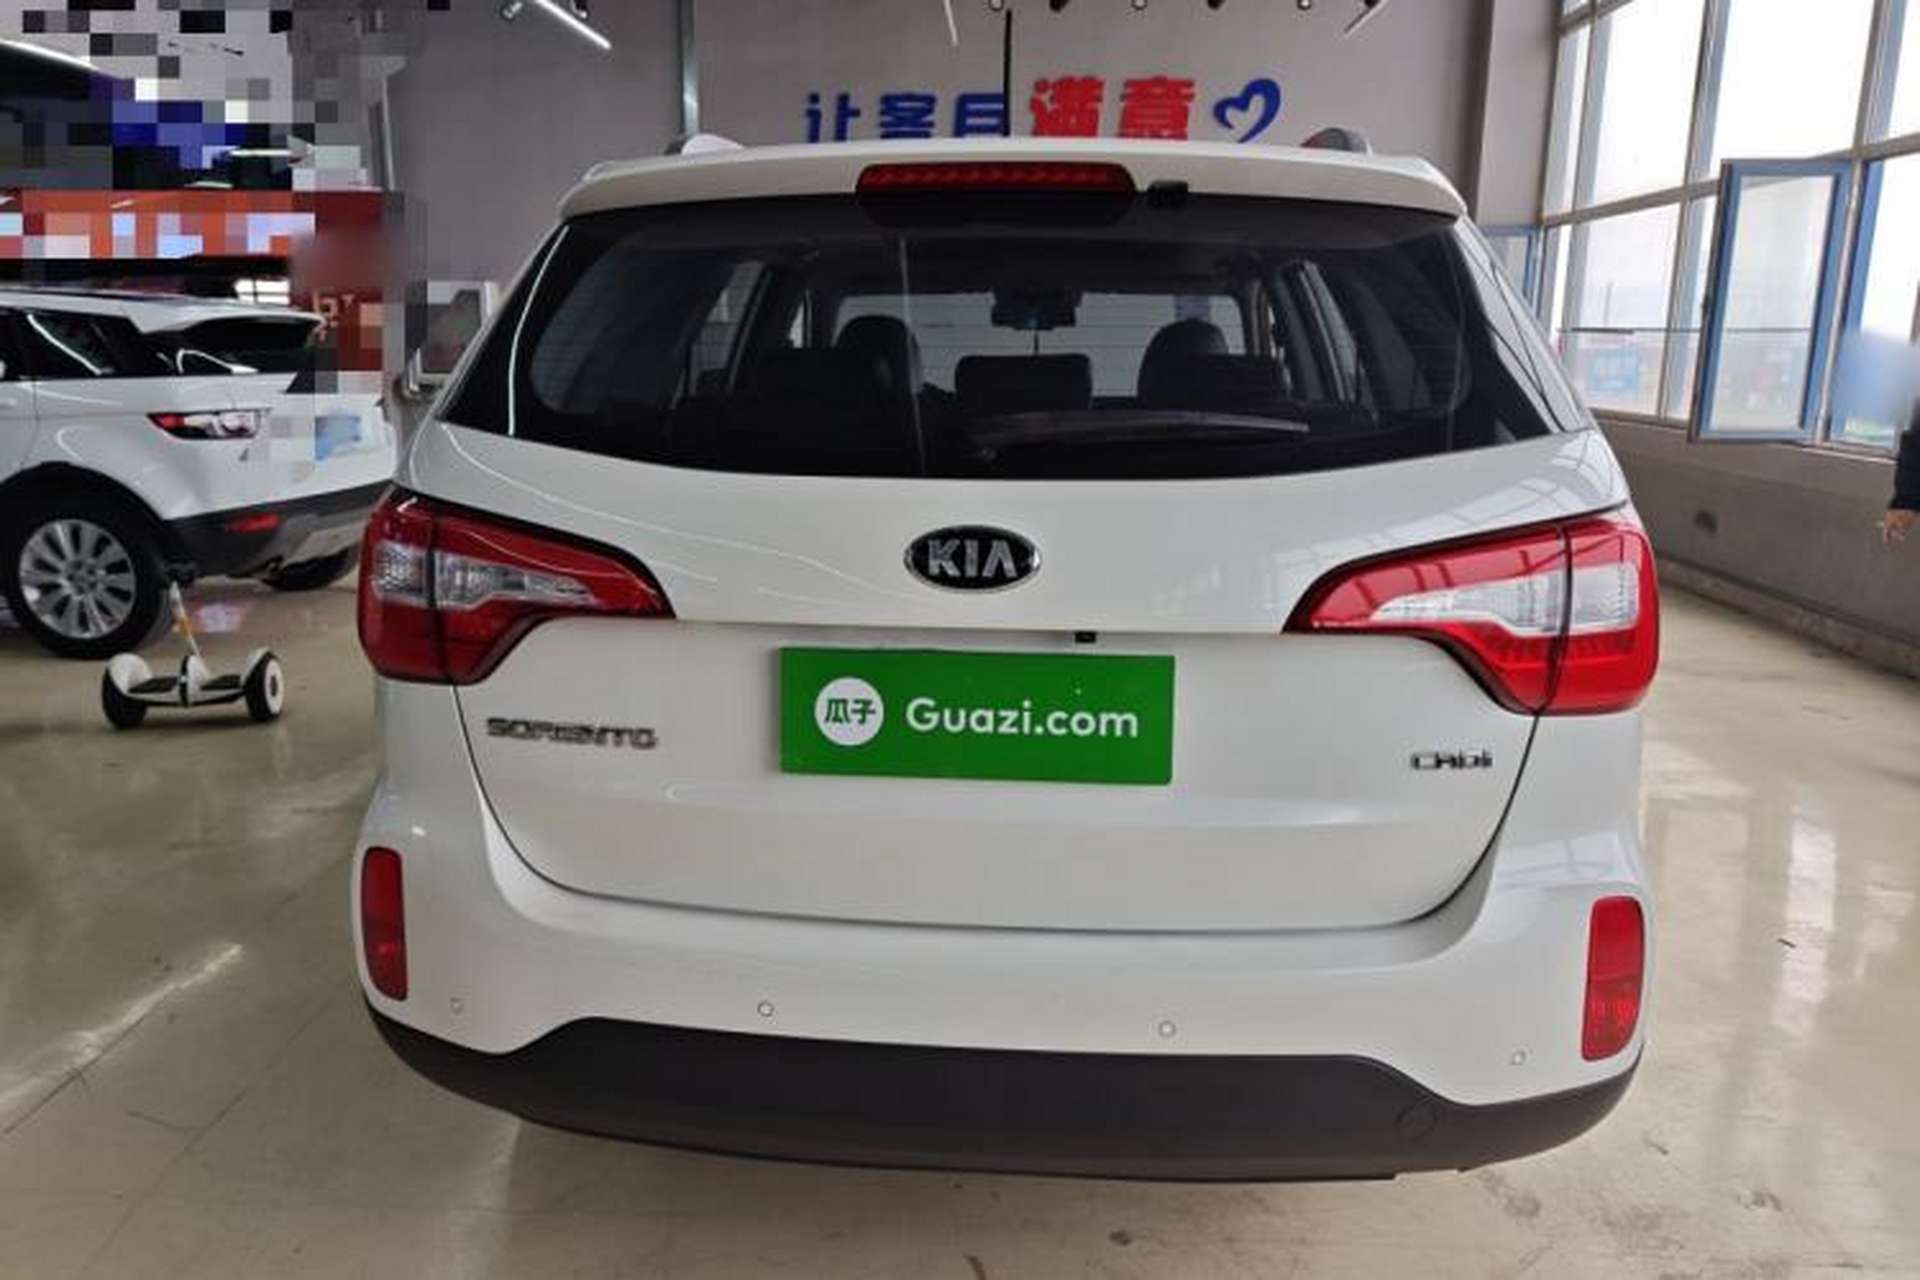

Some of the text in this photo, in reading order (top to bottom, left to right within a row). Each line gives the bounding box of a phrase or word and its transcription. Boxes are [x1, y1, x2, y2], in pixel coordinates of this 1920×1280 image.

[927, 538, 1018, 579] KIA
[824, 698, 877, 726] 瓜子
[905, 696, 1138, 738] Guazi.com
[487, 717, 658, 750] SORENTO
